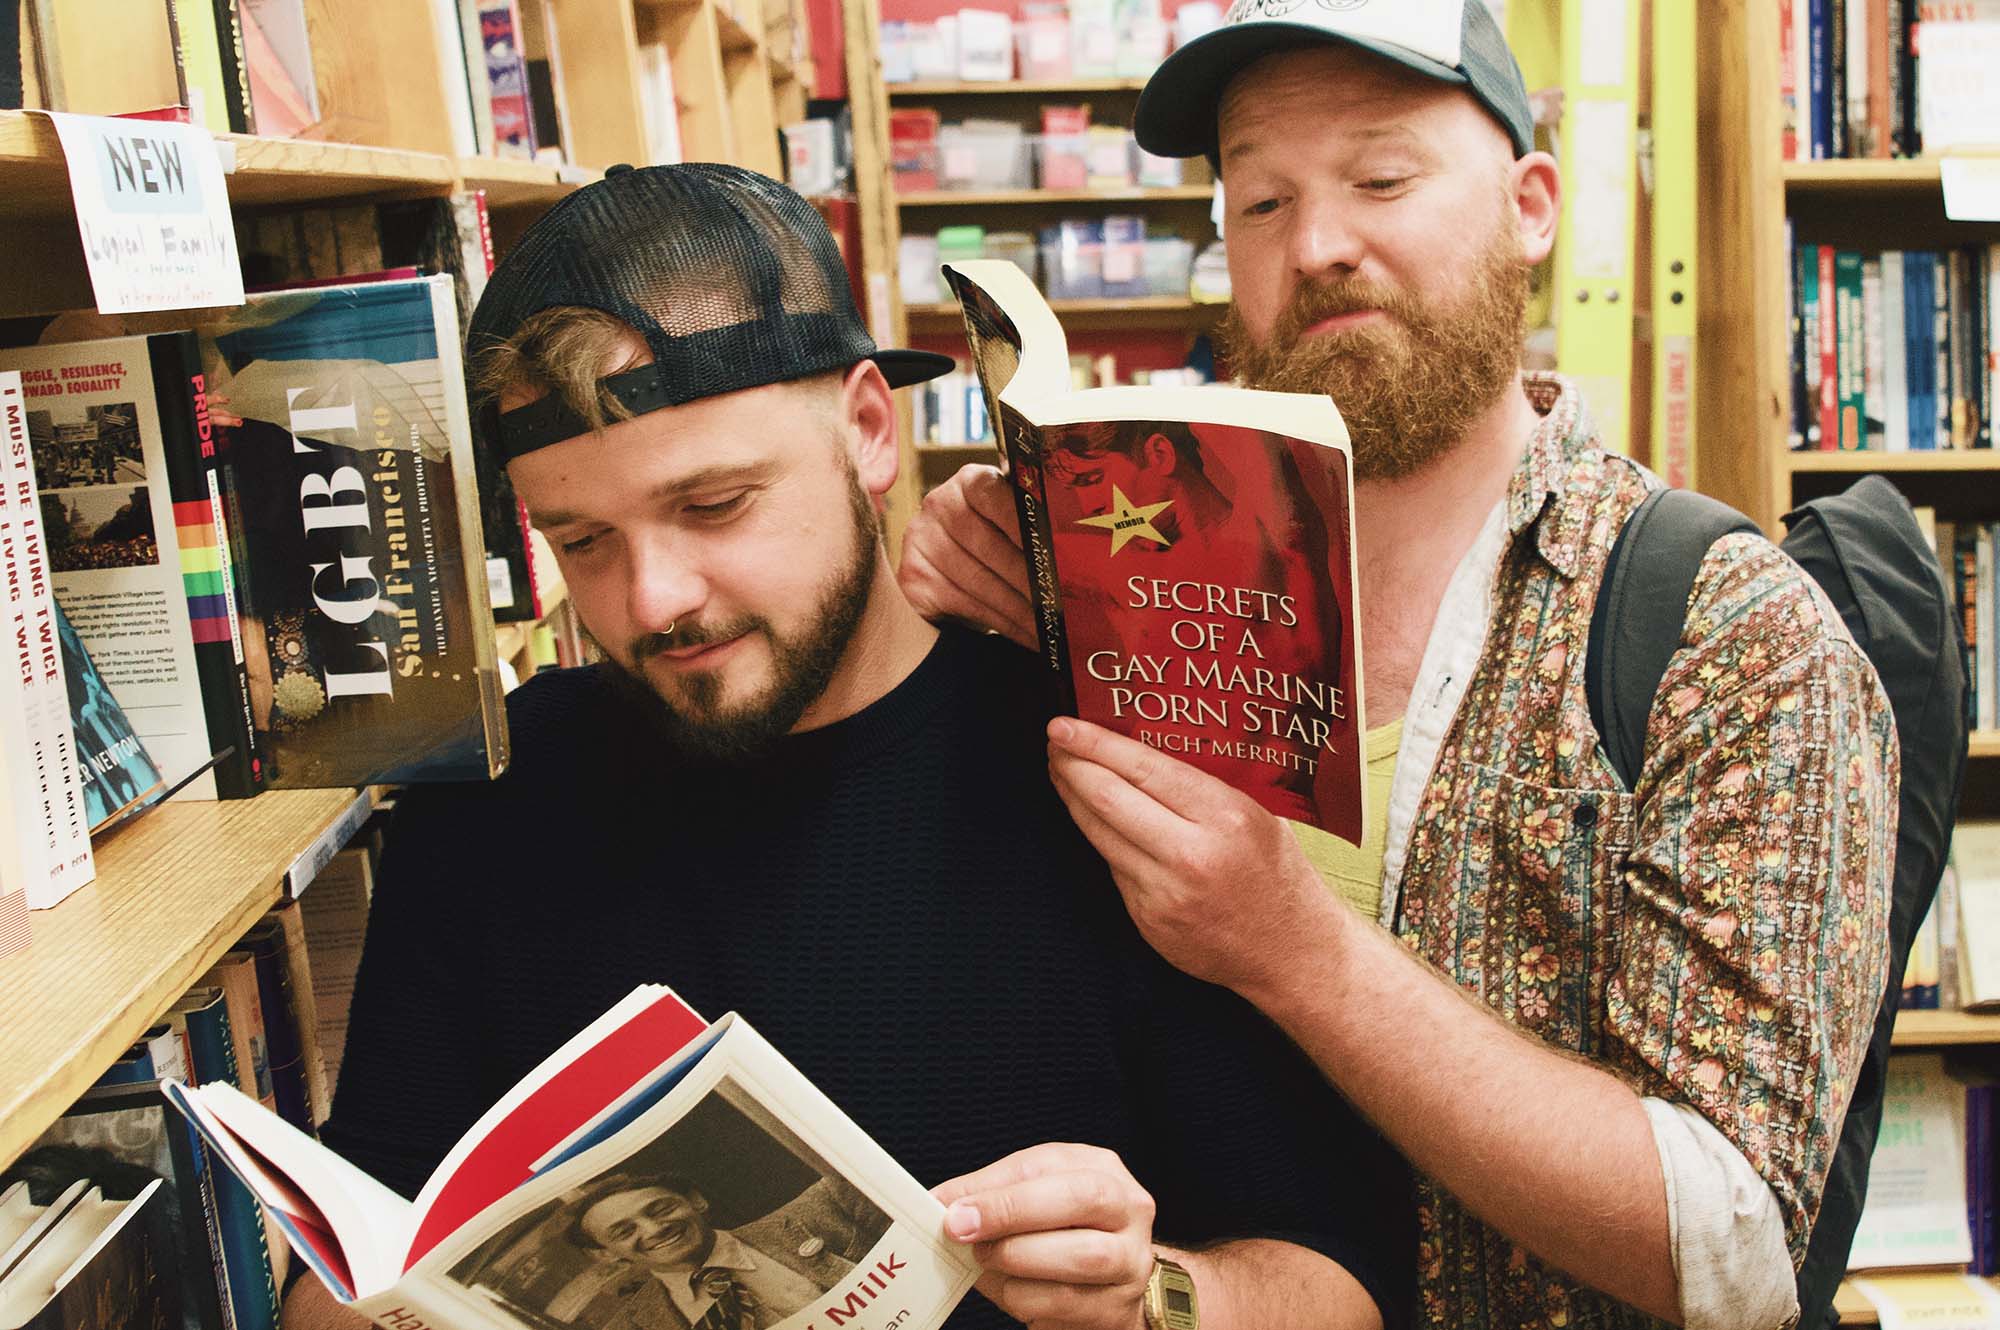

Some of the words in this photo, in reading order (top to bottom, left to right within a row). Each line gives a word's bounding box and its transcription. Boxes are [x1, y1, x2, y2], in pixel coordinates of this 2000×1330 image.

[103, 134, 184, 195] NEW
[60, 363, 127, 379] RESILIENCE,
[67, 378, 122, 394] EQUALITY
[6, 404, 28, 471] MUST
[191, 374, 215, 458] PRIDE
[18, 481, 33, 512] BE
[408, 422, 429, 512] PHOTOGRAPHS
[372, 406, 414, 595] Francisco
[1114, 516, 1146, 531] MEMOIR
[1123, 509, 1129, 518] A
[24, 520, 45, 599] LIVING
[287, 386, 394, 704] LGBT
[420, 517, 437, 582] NICOLETTA
[1, 522, 21, 602] LIVING
[14, 612, 34, 690] TWICE
[123, 590, 143, 599] Village
[429, 587, 444, 631] DANIEL
[1127, 576, 1297, 627] SECRETS
[36, 605, 58, 684] TWICE
[396, 607, 423, 678] San
[435, 632, 447, 656] THE
[1171, 620, 1225, 651] OF
[1236, 628, 1266, 659] A
[1087, 650, 1172, 684] GAY
[1184, 656, 1346, 720] MARINE
[1110, 687, 1228, 728] PORN
[1242, 701, 1338, 754] STAR
[92, 735, 142, 773] NEWTON
[1140, 730, 1200, 754] RICH
[1212, 739, 1318, 775] MERRITT
[824, 1252, 907, 1327] Milk
